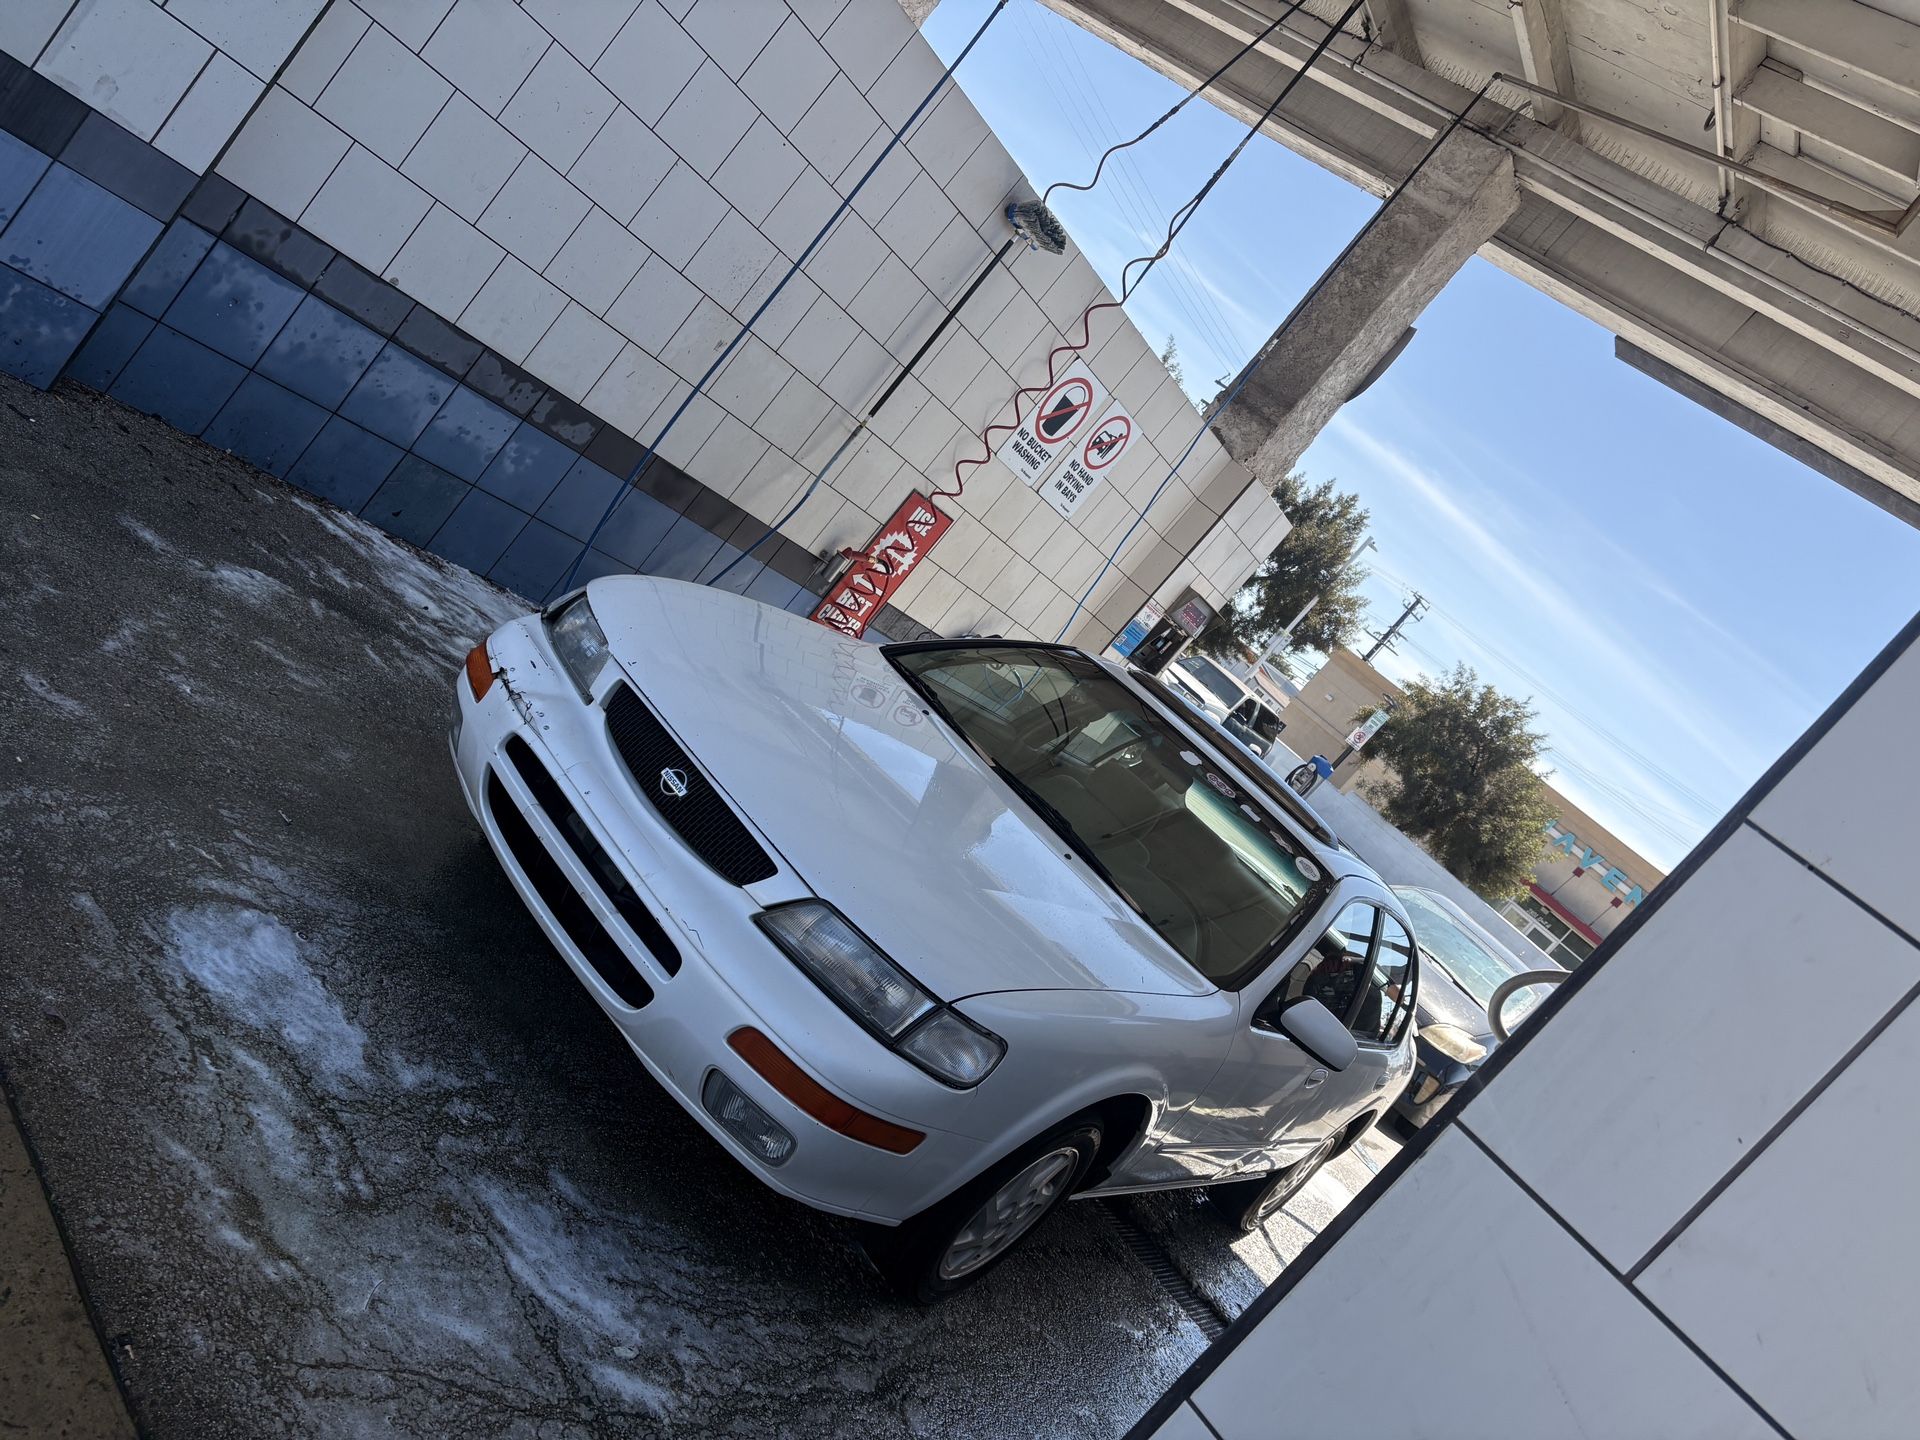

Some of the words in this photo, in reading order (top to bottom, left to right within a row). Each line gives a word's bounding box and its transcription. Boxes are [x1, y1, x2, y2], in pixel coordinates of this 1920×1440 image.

[1011, 440, 1041, 470] WASHING
[1016, 427, 1030, 441] NO
[1026, 436, 1052, 462] BUCKET
[1062, 470, 1084, 493] DRYING
[1068, 459, 1080, 472] NO
[1076, 467, 1094, 486] HAND
[1054, 479, 1064, 490] IN
[1060, 486, 1077, 503] BAYS
[905, 505, 937, 538] USE
[834, 587, 873, 618] BEST
[663, 770, 684, 794] NISSAN
